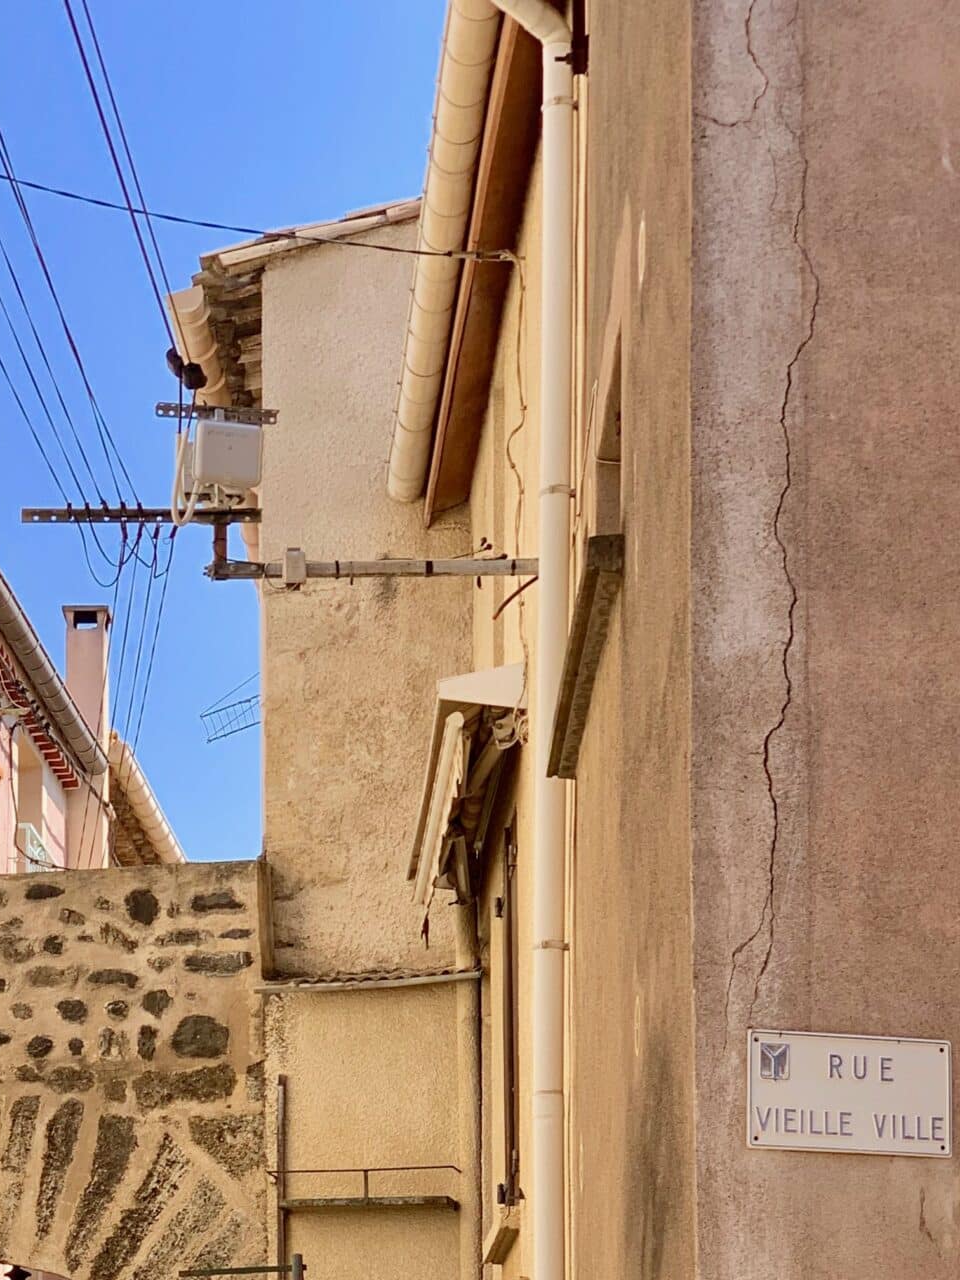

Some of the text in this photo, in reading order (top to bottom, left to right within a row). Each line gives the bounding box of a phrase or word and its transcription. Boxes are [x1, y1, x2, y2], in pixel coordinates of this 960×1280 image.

[829, 1054, 894, 1082] RUE
[756, 1106, 944, 1141] VIEILLE VILLE
